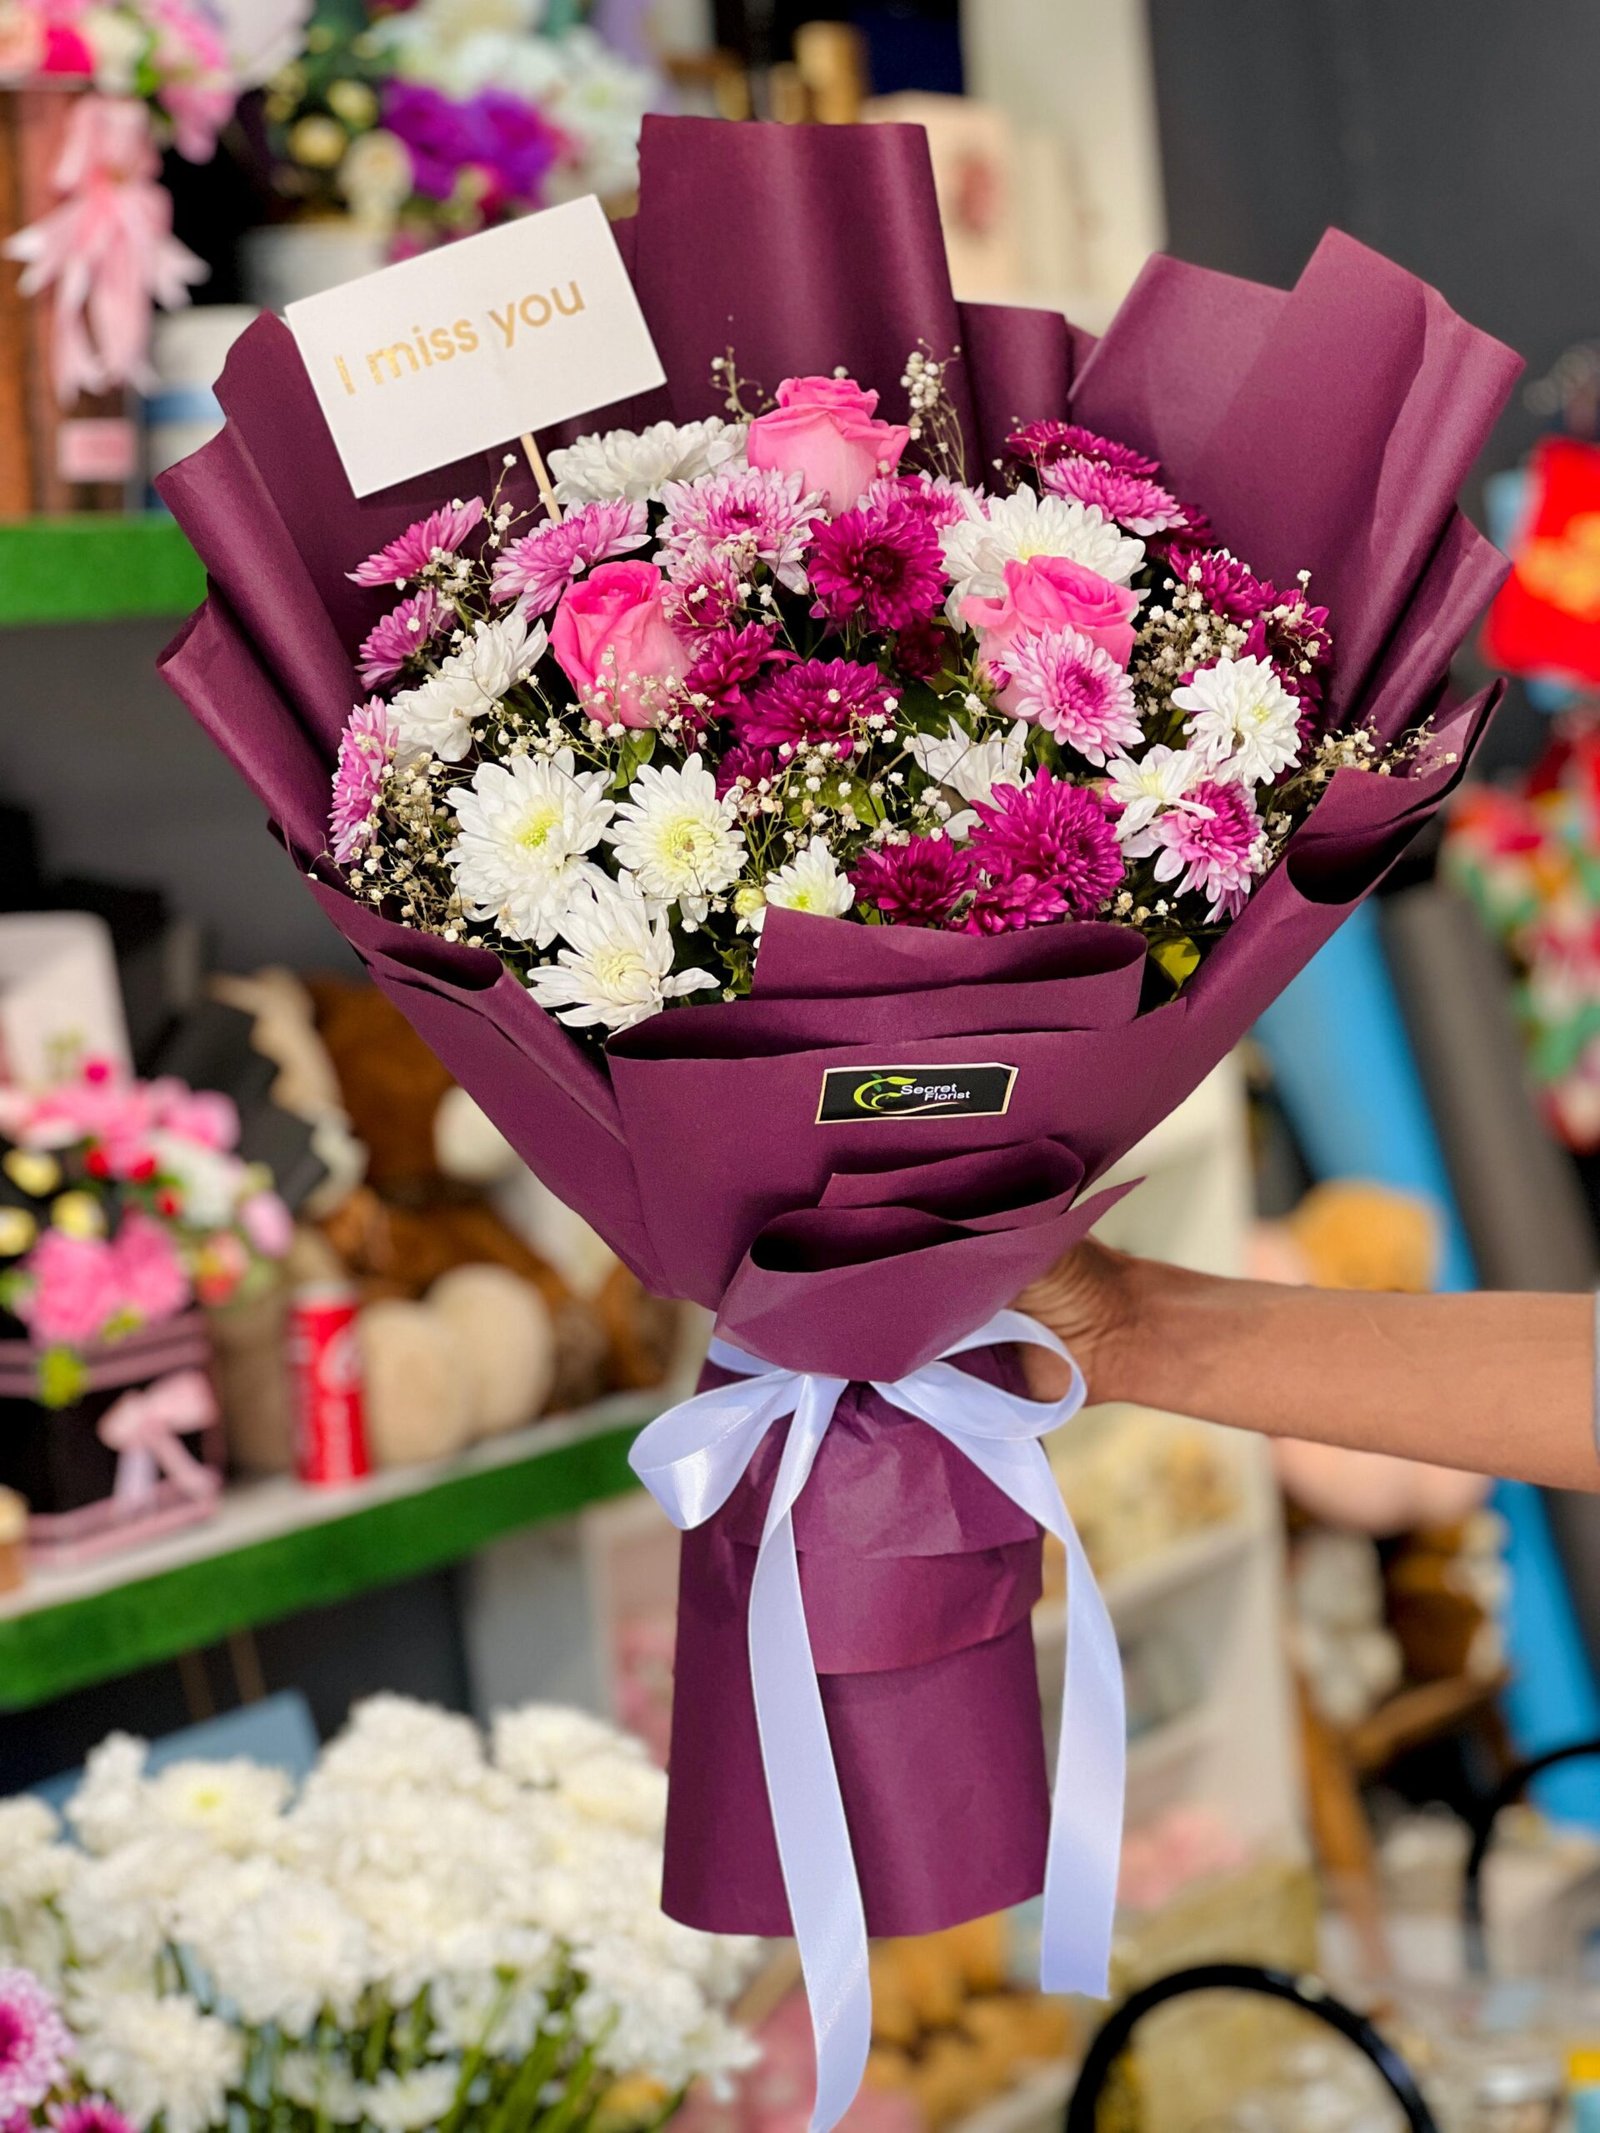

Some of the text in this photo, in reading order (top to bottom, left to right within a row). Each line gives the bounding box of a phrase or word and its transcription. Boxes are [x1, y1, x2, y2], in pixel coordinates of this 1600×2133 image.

[334, 280, 586, 396] I miss you
[900, 1083, 958, 1096] Secret
[924, 1090, 971, 1101] Florist
